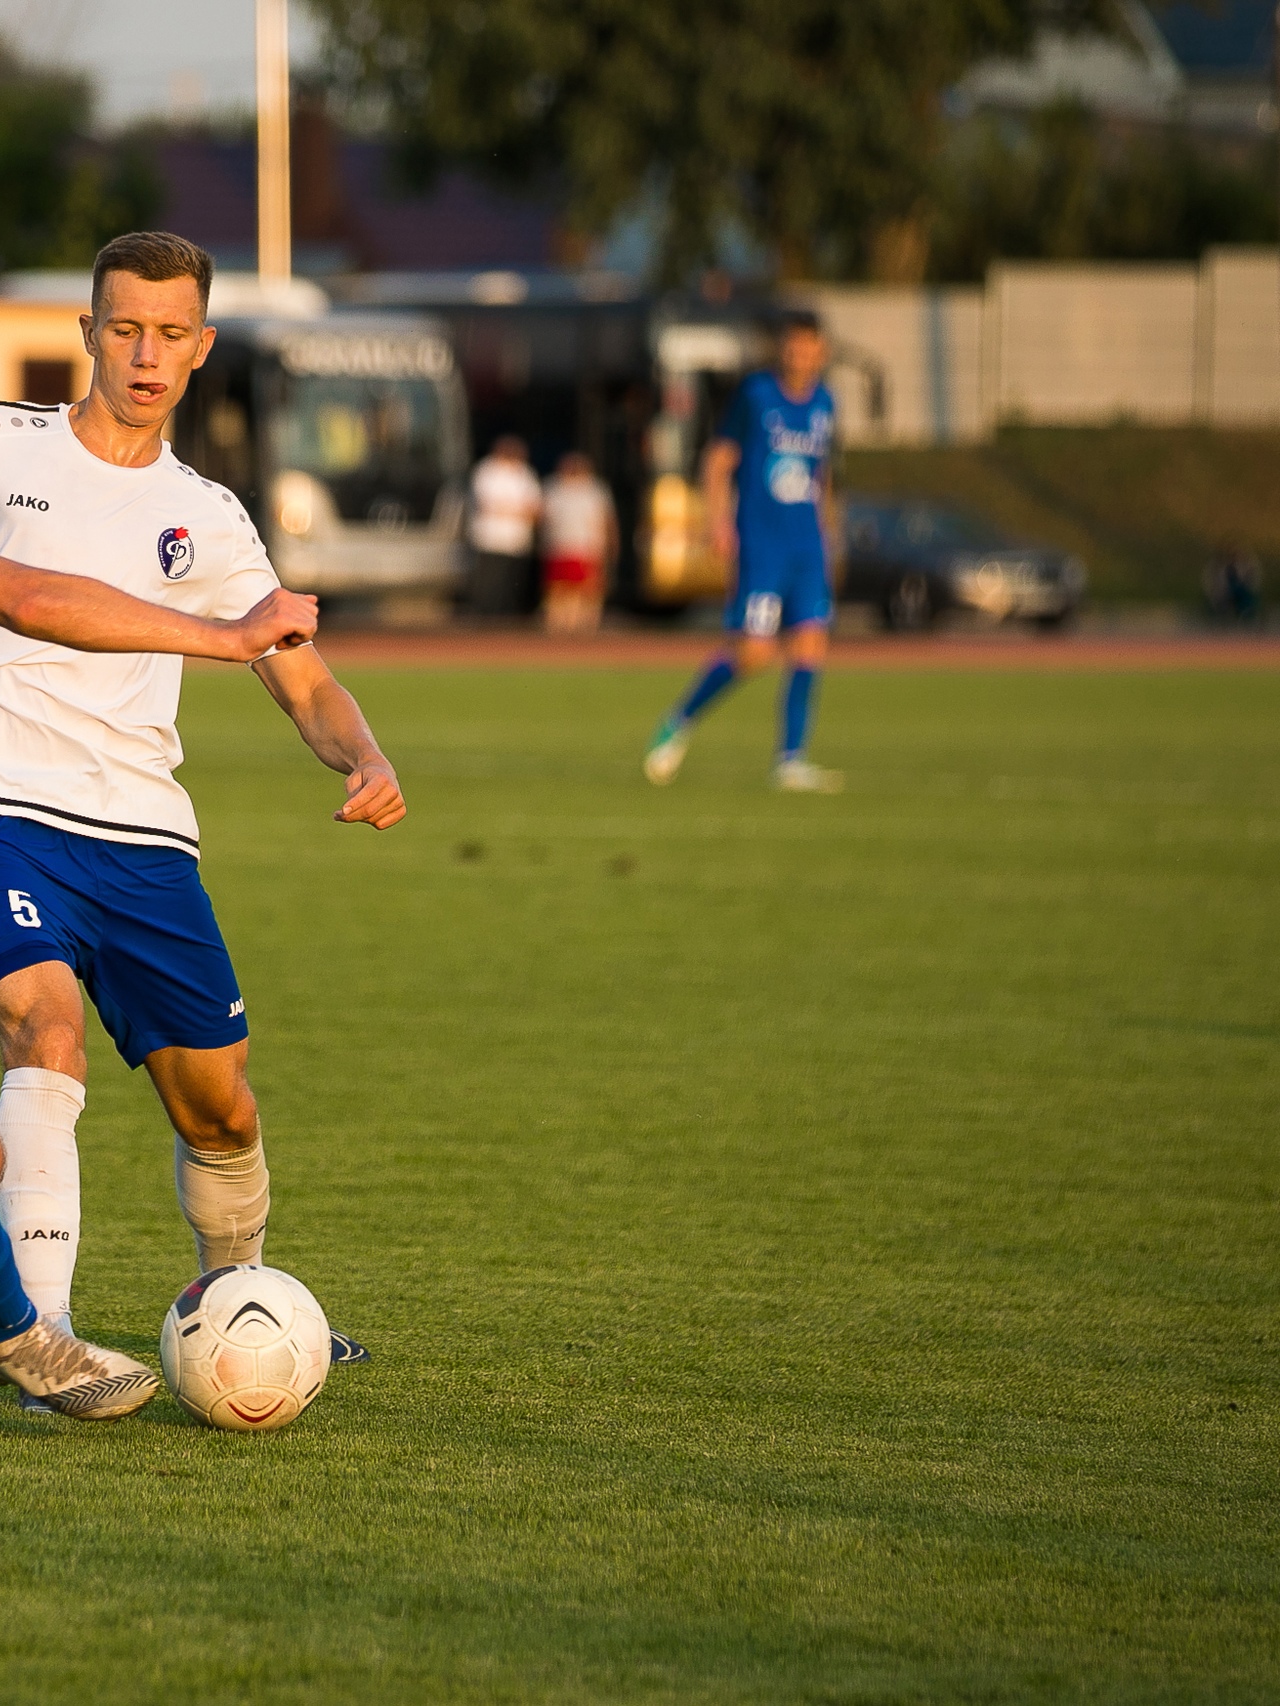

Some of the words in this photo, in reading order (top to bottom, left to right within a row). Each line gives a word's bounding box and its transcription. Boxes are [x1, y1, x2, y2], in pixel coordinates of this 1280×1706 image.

[6, 493, 50, 512] JAKO
[7, 889, 42, 928] 5
[20, 1229, 70, 1241] JAKO
